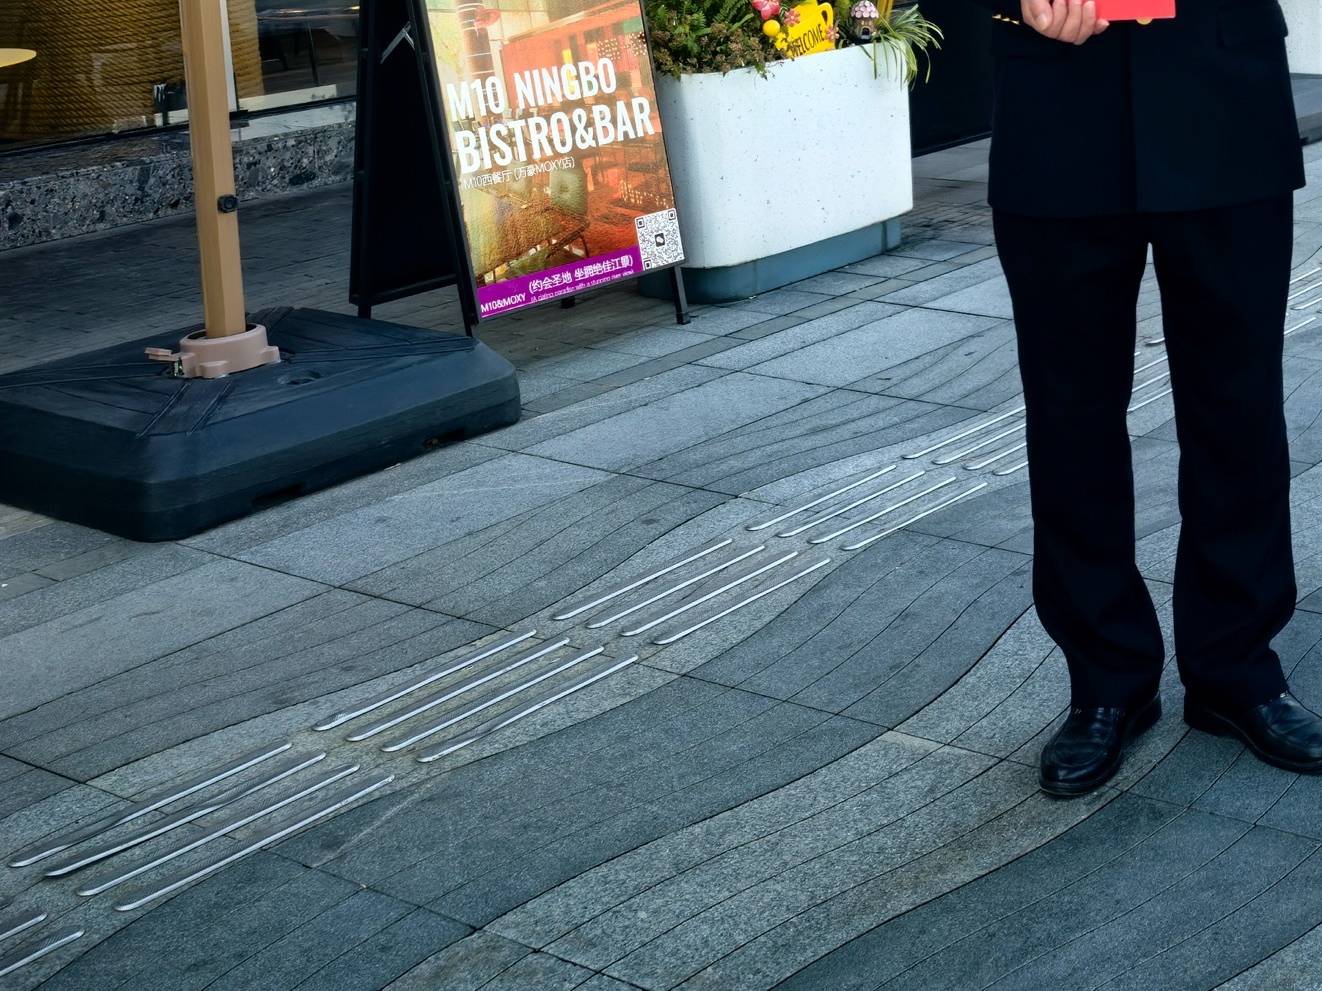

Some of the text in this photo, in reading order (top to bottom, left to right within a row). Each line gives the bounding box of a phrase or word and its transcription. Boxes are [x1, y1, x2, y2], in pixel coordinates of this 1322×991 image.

[446, 57, 617, 121] M10 NINGBO
[454, 96, 655, 174] BISTRO&BAR
[462, 169, 512, 189] M10西餐厅
[480, 293, 526, 313] M10&MOXY
